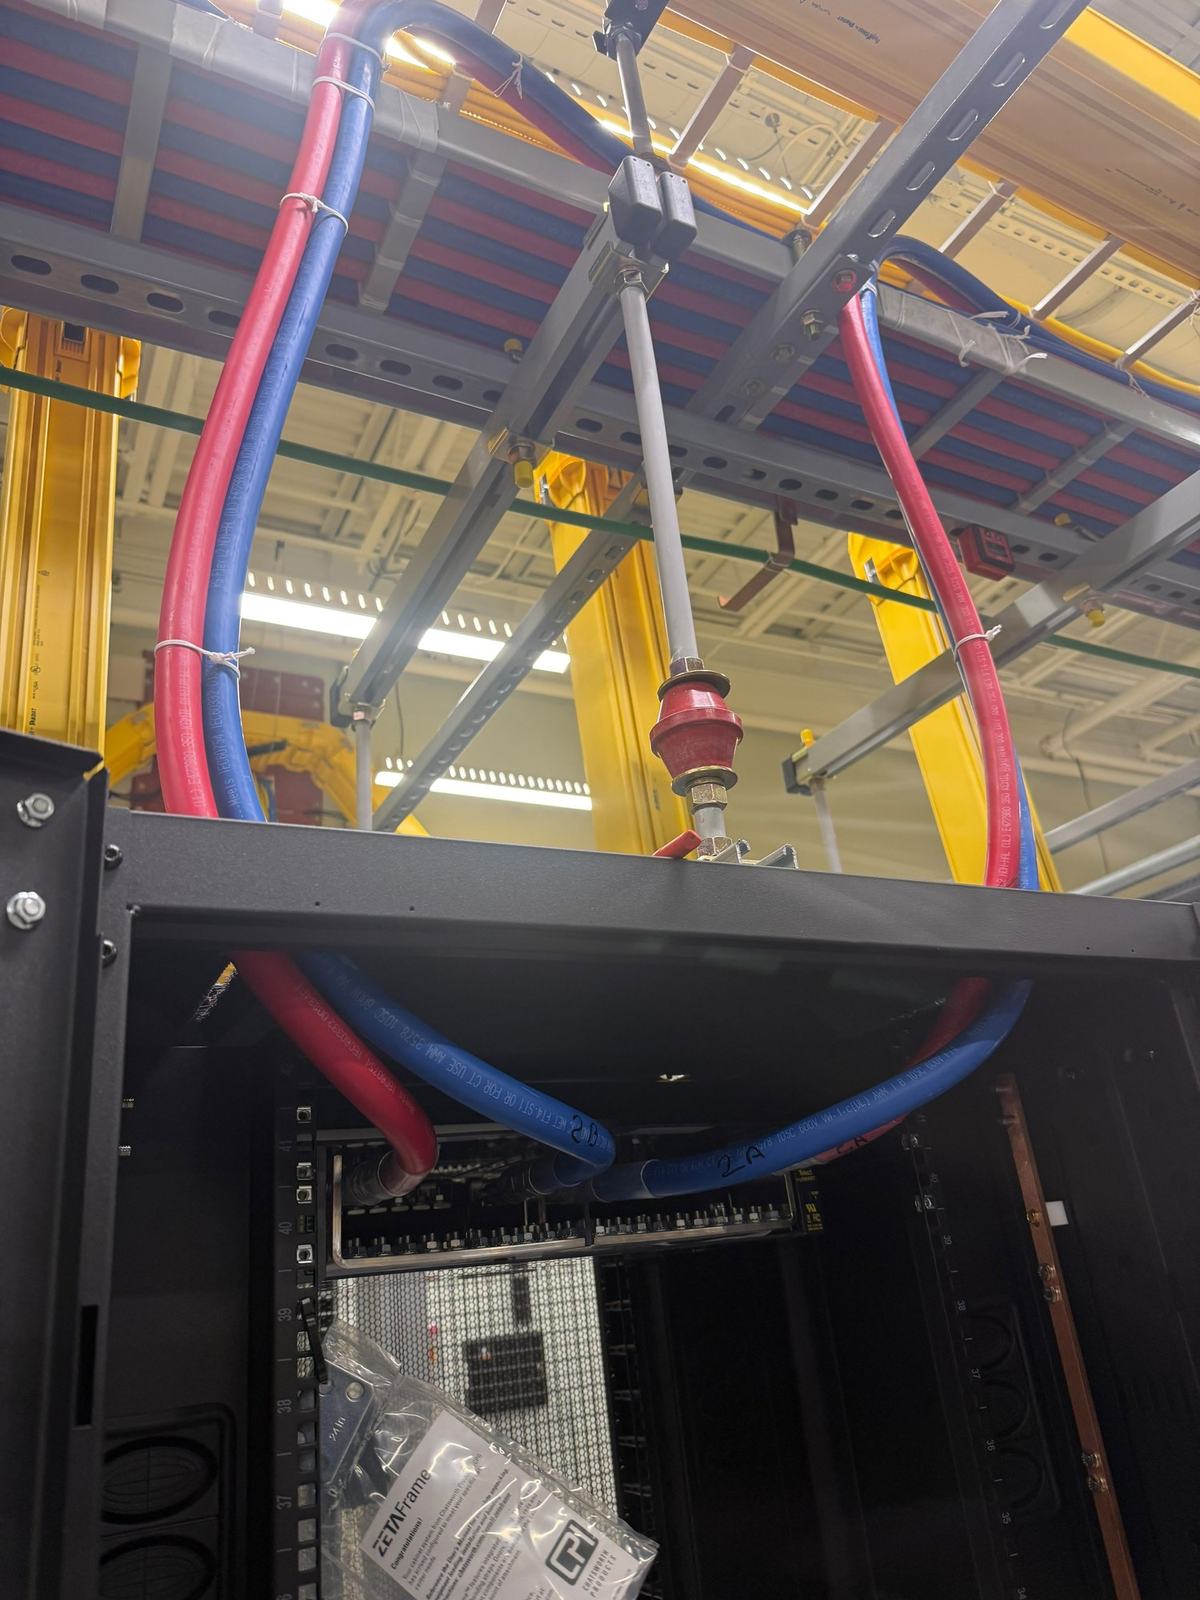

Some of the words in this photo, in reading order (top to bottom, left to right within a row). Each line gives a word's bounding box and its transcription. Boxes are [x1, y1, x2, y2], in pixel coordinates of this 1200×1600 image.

[278, 1220, 293, 1235] 40
[278, 1307, 292, 1322] 39
[277, 1399, 292, 1415] 38
[276, 1495, 293, 1510] 37
[371, 1468, 432, 1557] ZETAFrame
[390, 1517, 423, 1571] Congratulations!
